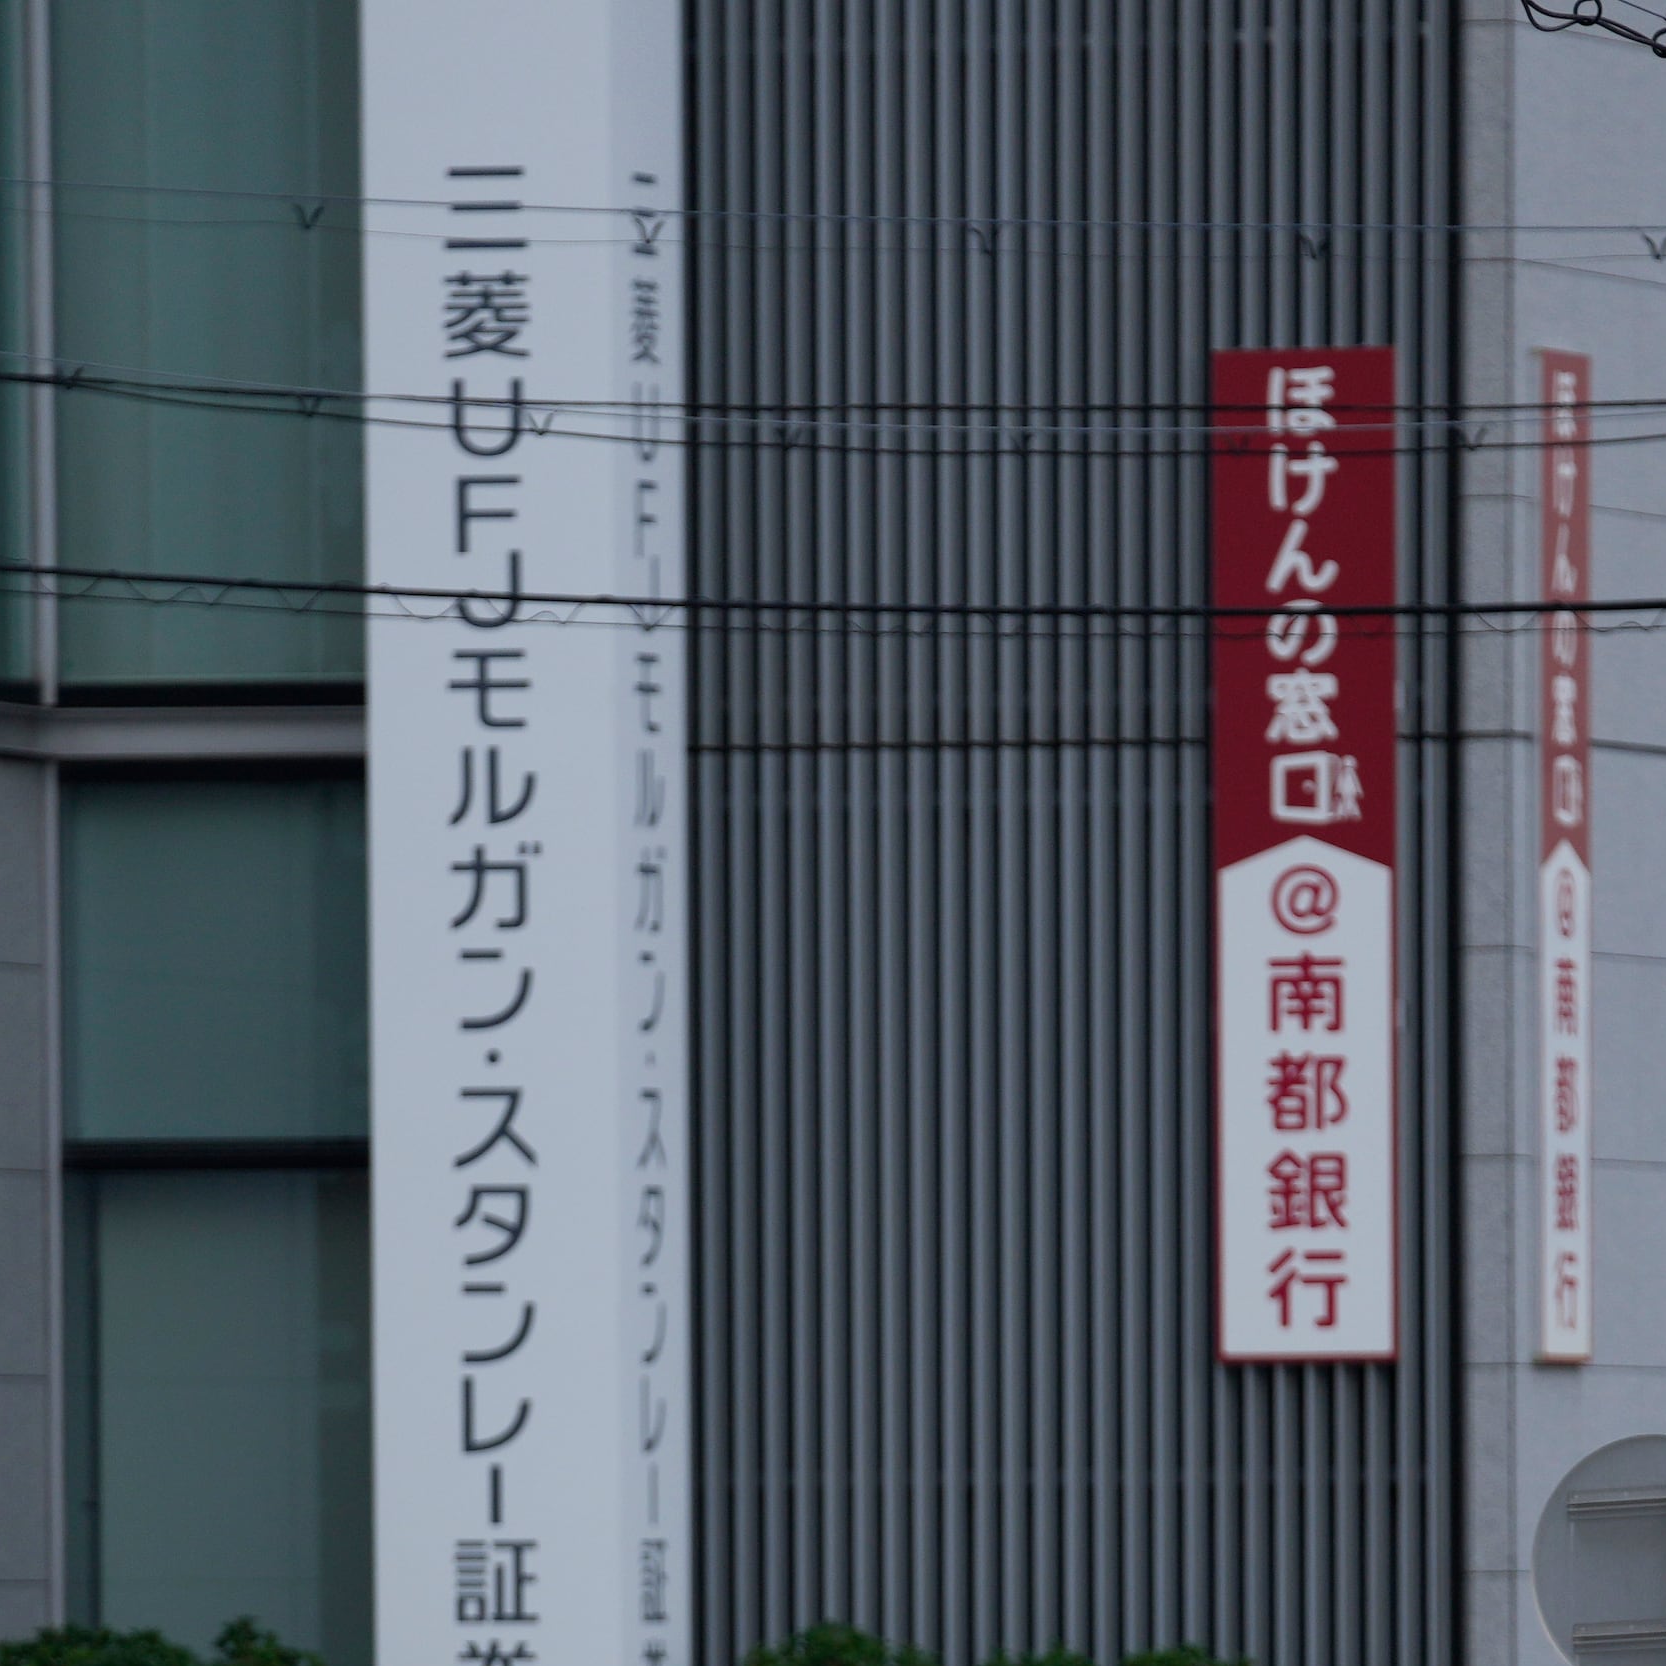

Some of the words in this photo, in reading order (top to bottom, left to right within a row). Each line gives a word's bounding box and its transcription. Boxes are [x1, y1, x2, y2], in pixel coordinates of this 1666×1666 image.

[1265, 365, 1340, 825] ほけんの窓口
[1267, 864, 1350, 1329] @南都銀行
